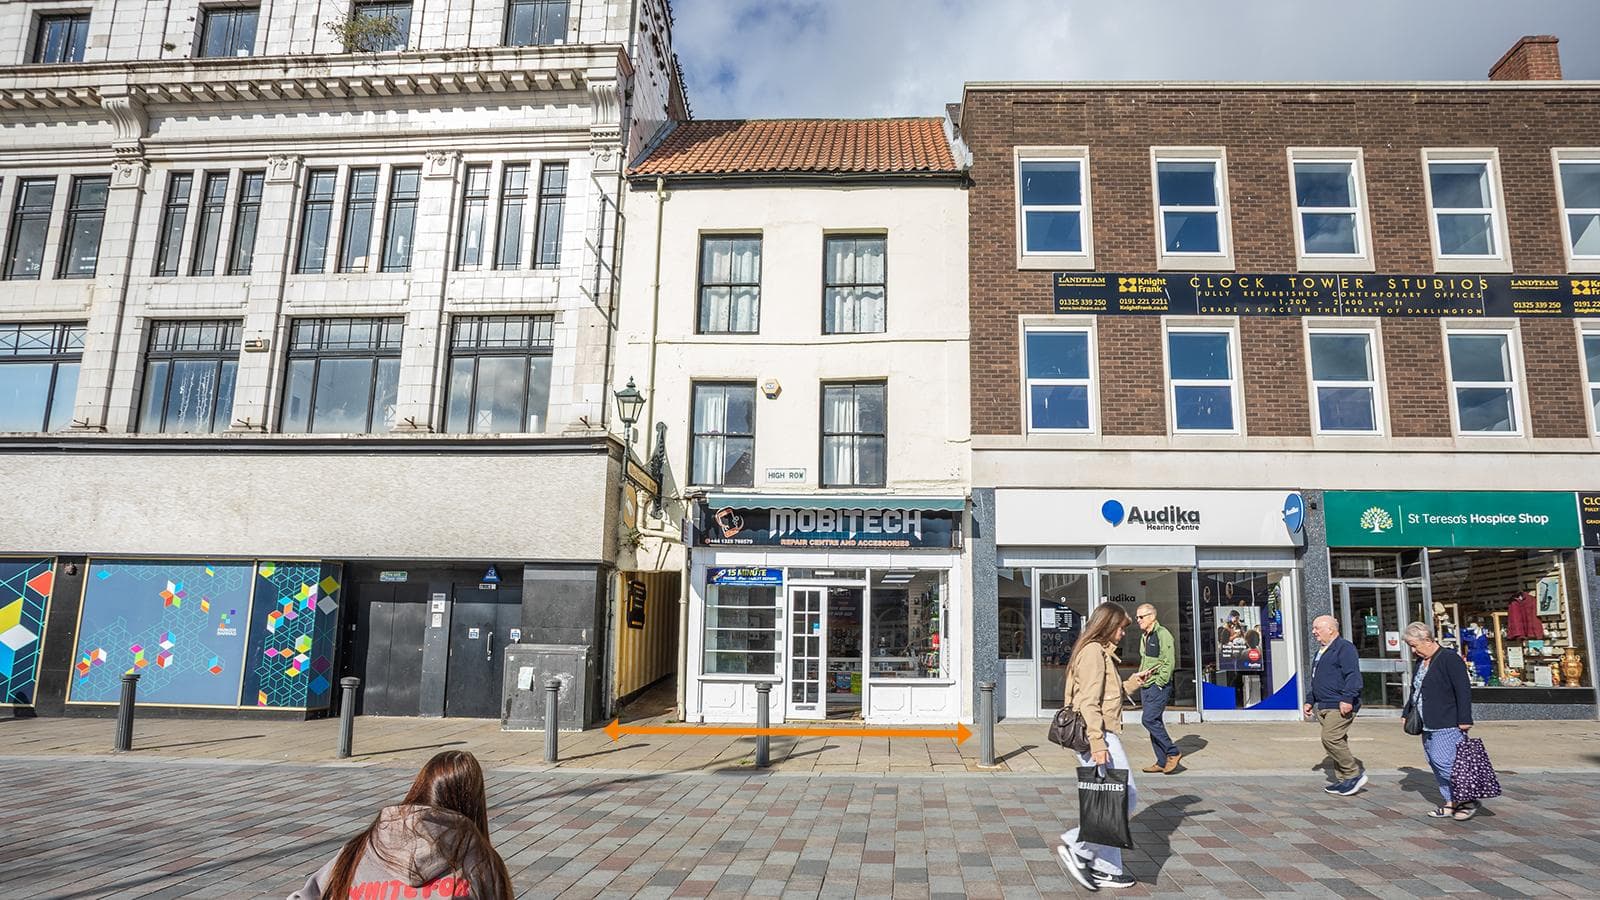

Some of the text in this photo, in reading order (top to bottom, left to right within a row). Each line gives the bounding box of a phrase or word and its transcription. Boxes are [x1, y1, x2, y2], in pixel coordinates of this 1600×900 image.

[1137, 277, 1167, 286] Knight
[1189, 277, 1489, 290] CLOCK TOWER STUDIOS
[1331, 290, 1421, 298] CONTEMPORARY
[1059, 298, 1080, 306] 01325
[1513, 301, 1534, 309] 01325
[768, 471, 804, 479] HIGH ROW
[1127, 505, 1201, 525] Audika
[1407, 513, 1549, 526] St Teresa's Hospice Shop
[769, 508, 922, 542] MOBITECH
[1146, 524, 1174, 532] Hearing
[780, 538, 910, 548] REPAIR CENTRE AND ACCESSORIES
[727, 568, 767, 577] 15 MINUTE
[348, 877, 470, 900] WHITE FOX
